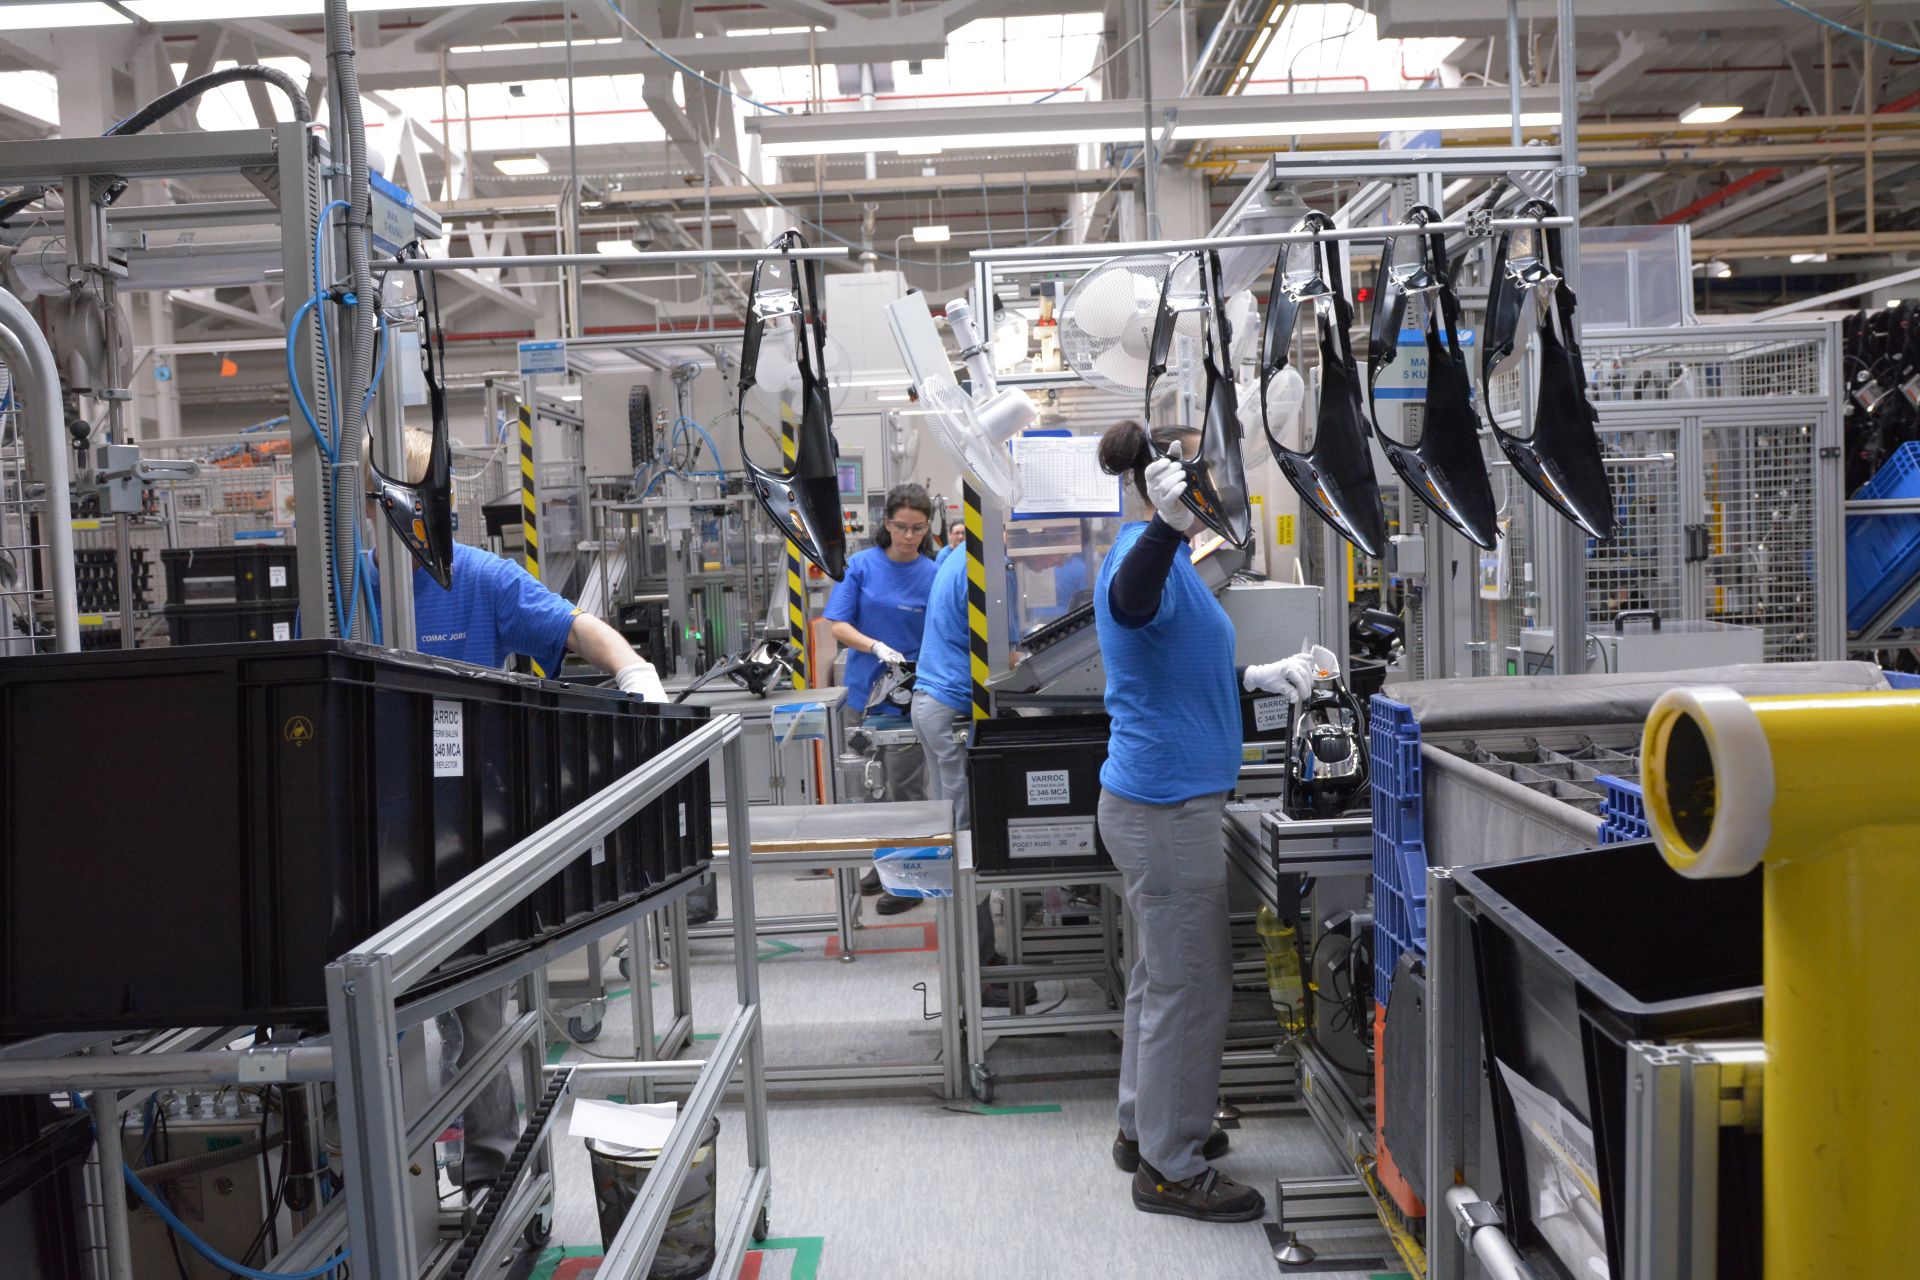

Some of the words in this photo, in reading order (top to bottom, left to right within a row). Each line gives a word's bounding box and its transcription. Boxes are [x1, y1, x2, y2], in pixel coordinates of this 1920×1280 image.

[1358, 288, 1368, 302] 2
[1410, 358, 1426, 368] MA
[1403, 370, 1409, 379] 5
[1412, 370, 1426, 379] KU
[433, 710, 458, 724] ARROC
[434, 744, 445, 756] 346
[446, 744, 461, 757] MCA
